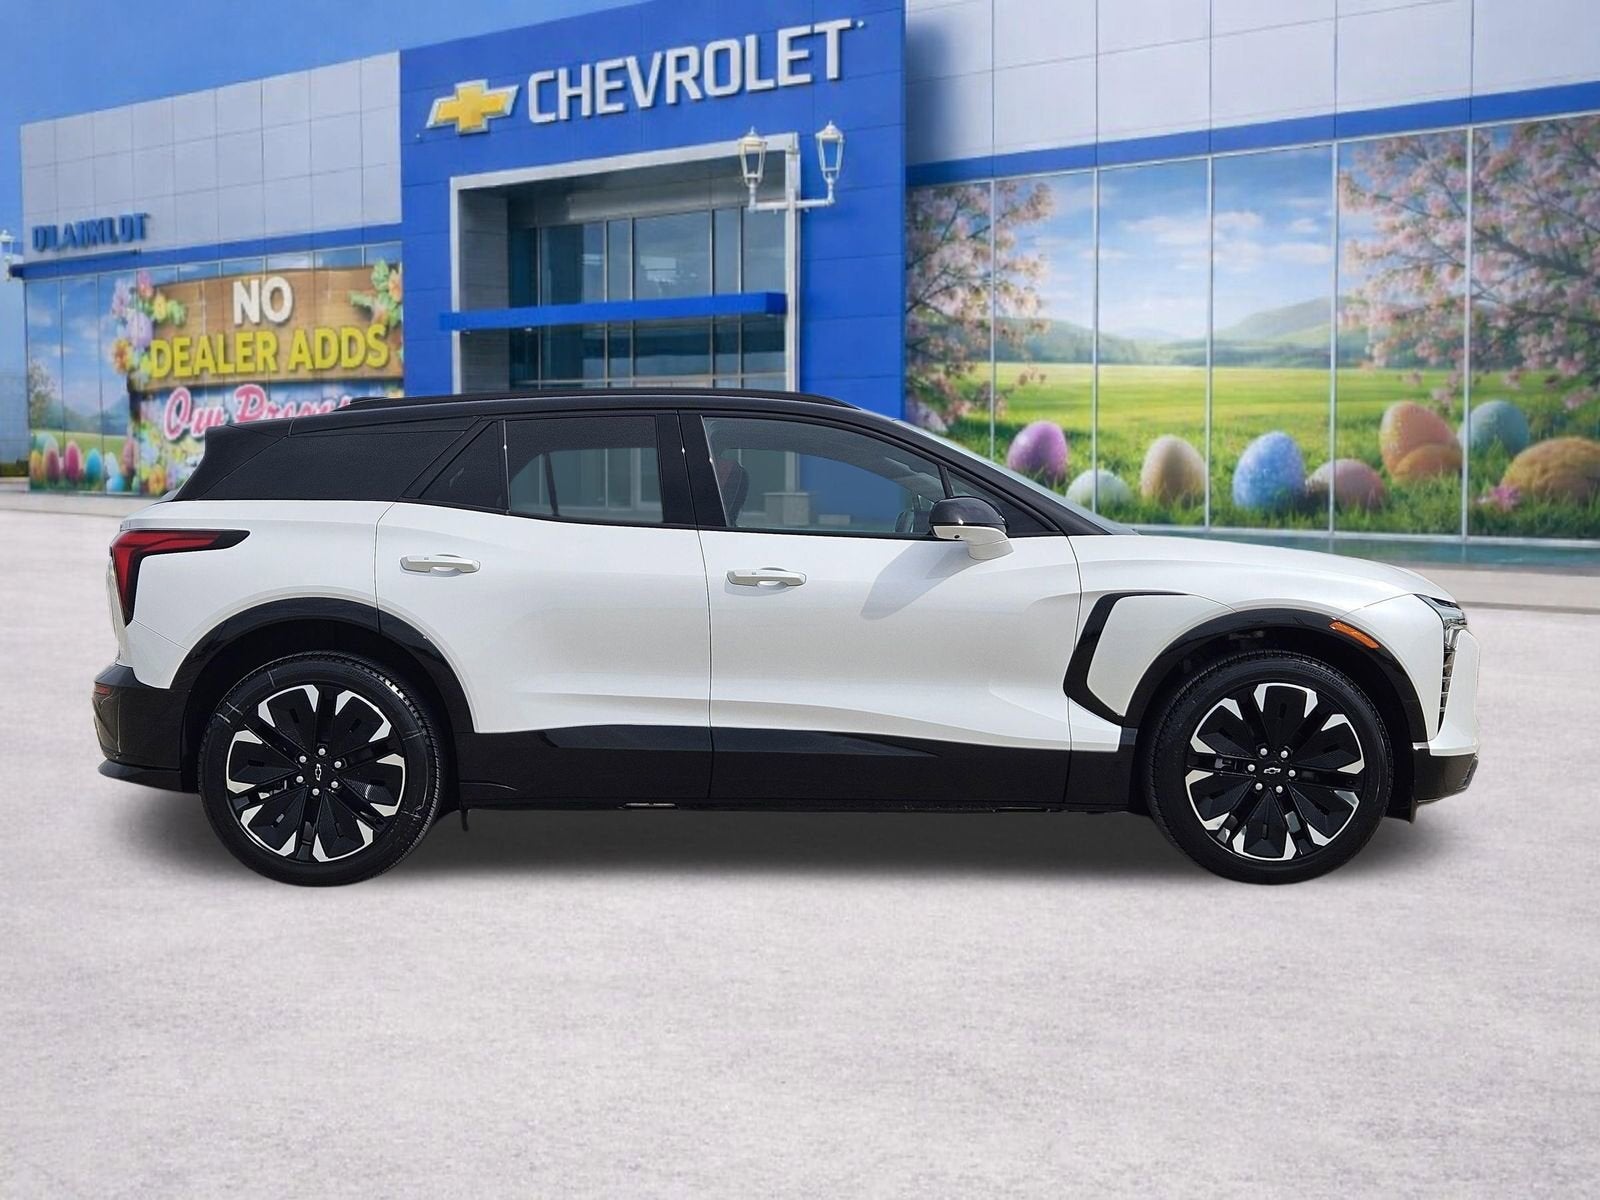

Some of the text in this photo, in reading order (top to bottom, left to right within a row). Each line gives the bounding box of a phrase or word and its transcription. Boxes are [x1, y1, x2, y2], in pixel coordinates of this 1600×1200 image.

[528, 18, 851, 124] CHEVROLET
[232, 276, 293, 325] NO
[151, 324, 389, 378] DEALER ADDS
